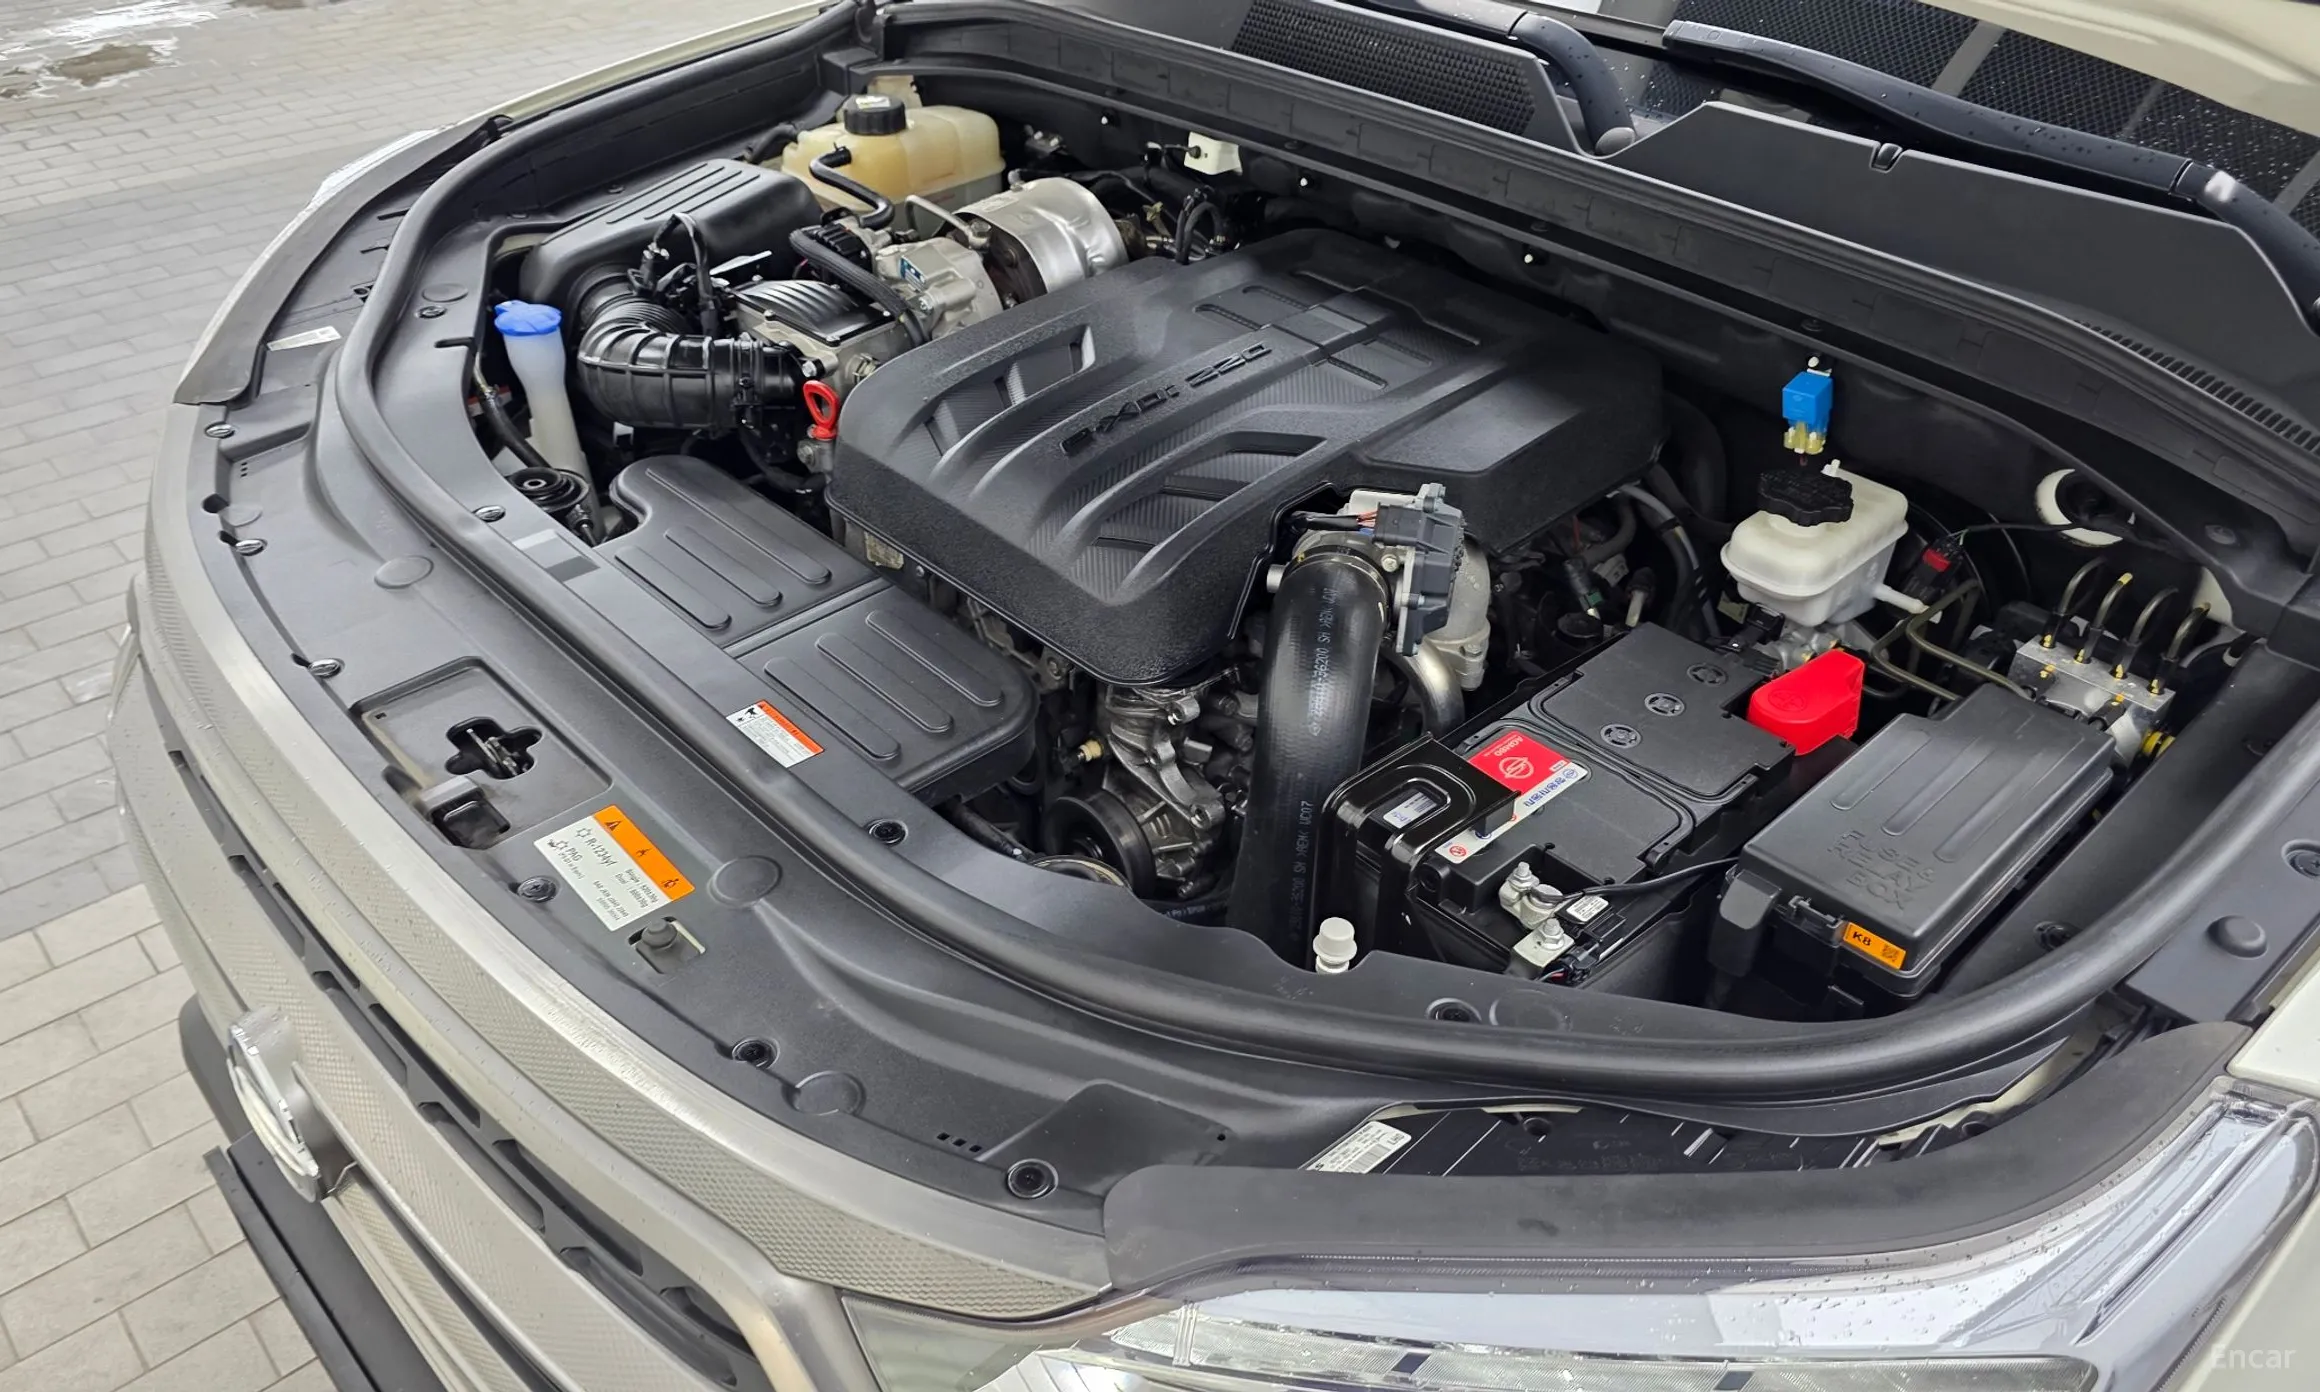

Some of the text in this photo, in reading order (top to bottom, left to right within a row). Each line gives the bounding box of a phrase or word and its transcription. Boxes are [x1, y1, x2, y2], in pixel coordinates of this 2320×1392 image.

[1185, 342, 1272, 388] 220
[1841, 829, 1919, 872] FUSE
[1852, 931, 1872, 947] K8
